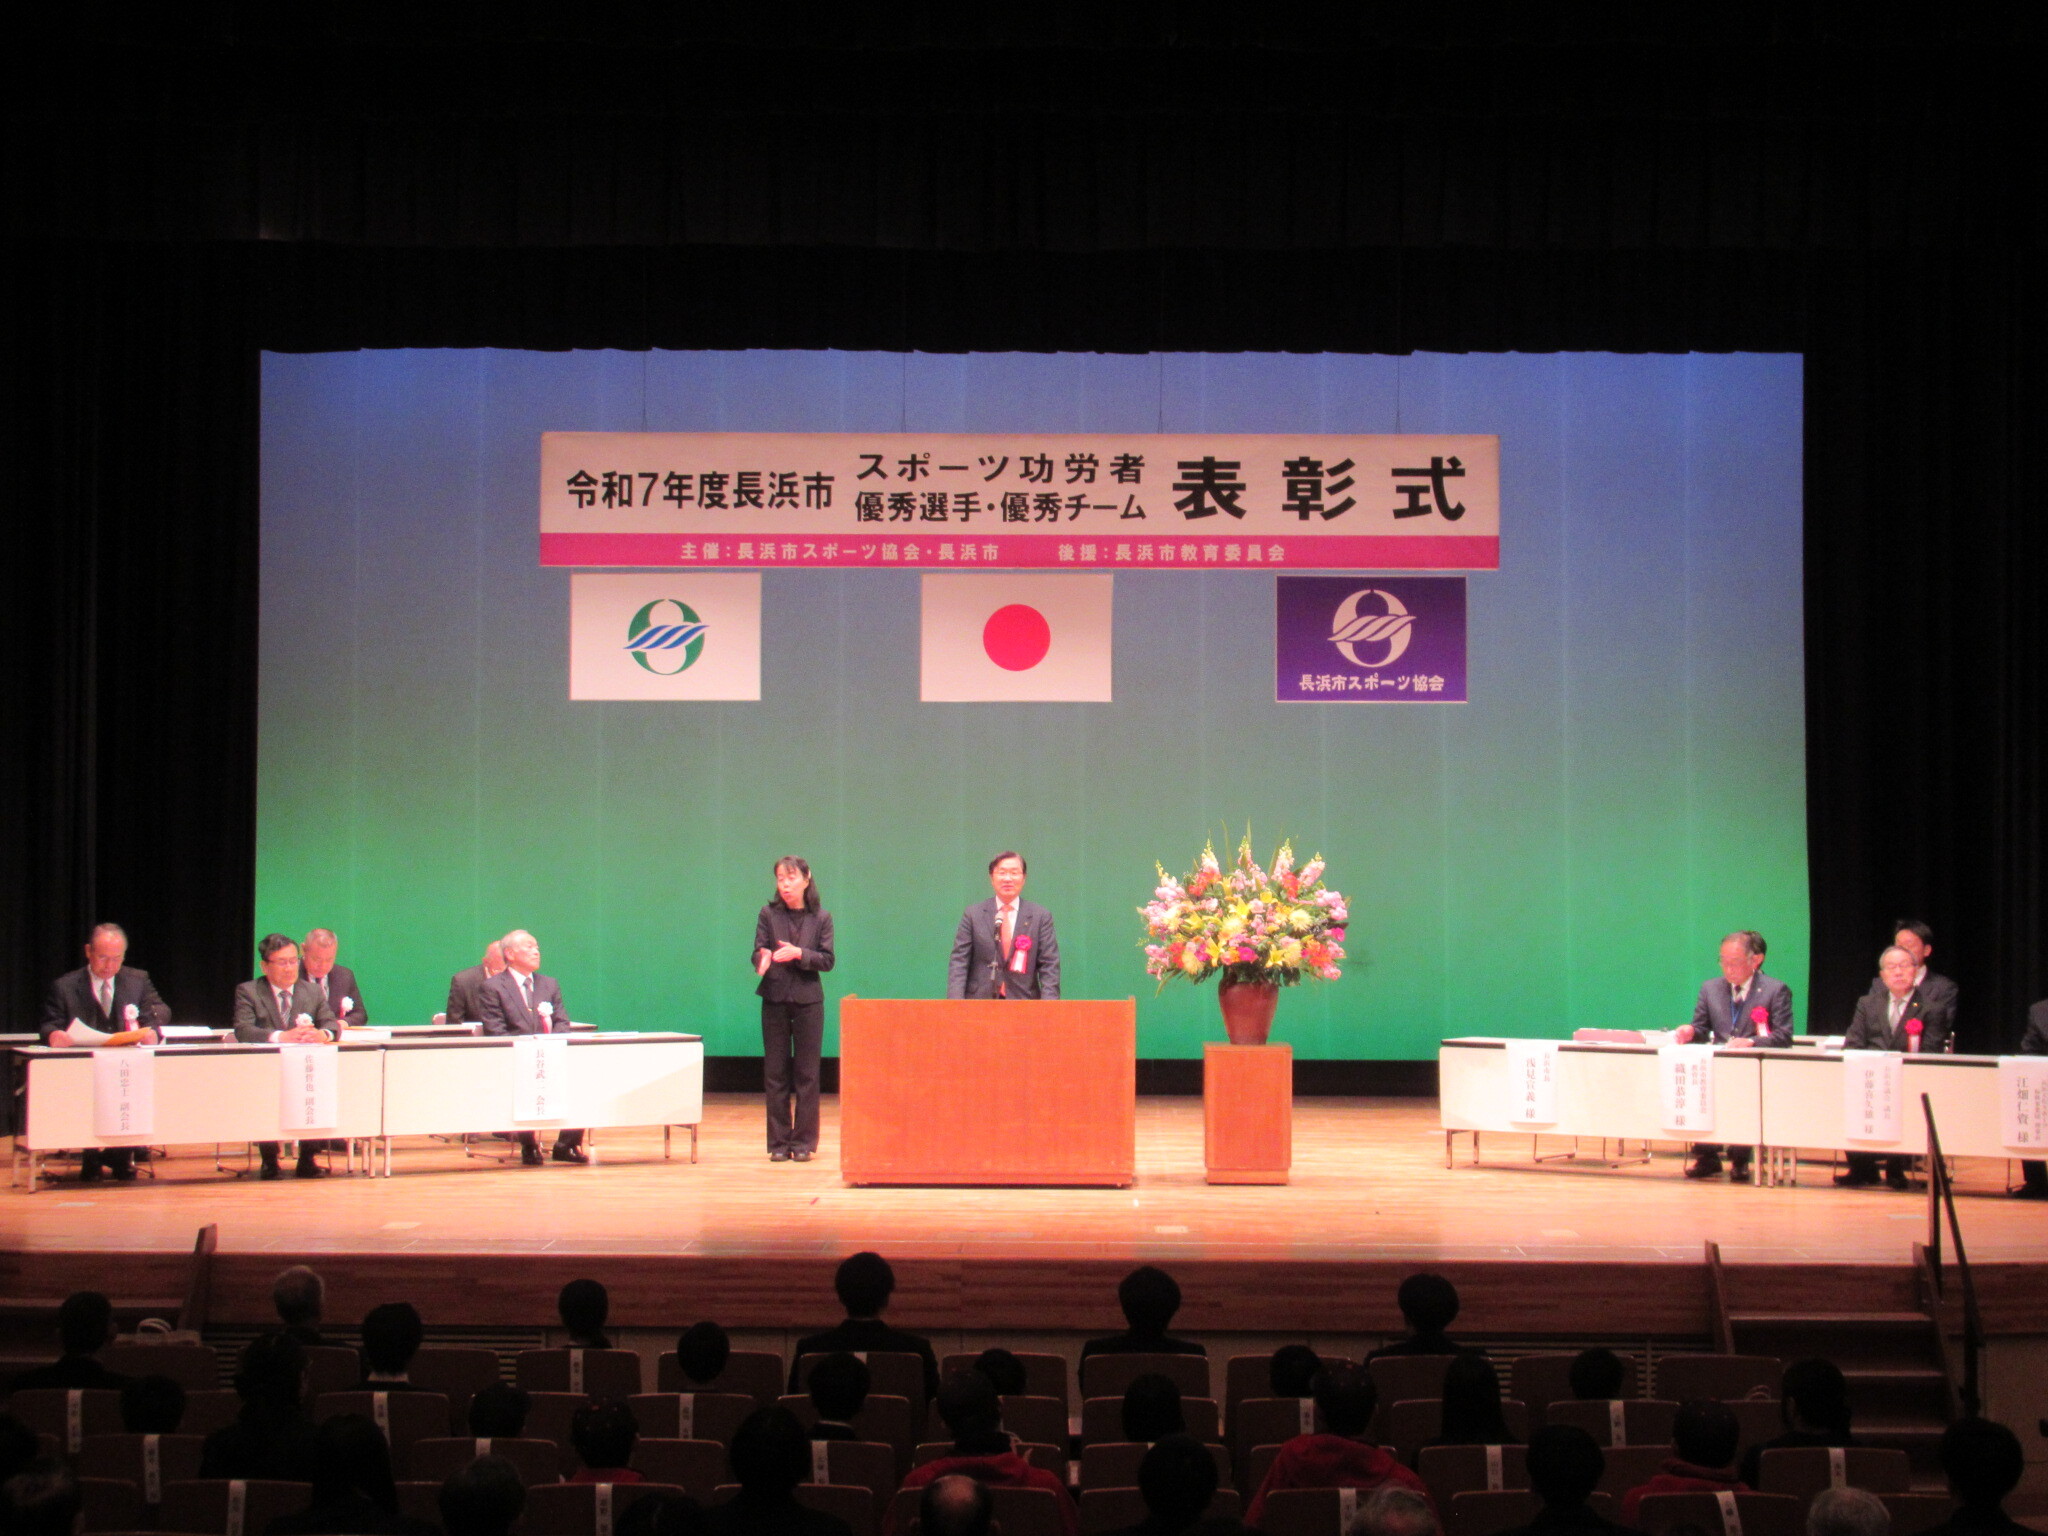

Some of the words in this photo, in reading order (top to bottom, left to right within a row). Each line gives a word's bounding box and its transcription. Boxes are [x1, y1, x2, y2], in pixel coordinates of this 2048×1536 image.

[856, 453, 1145, 485] スポーツ功労者
[566, 470, 835, 510] 令和7年度長浜市
[1172, 456, 1466, 521] 表彰式
[855, 491, 1146, 523] 優秀選手・優秀チーム
[1299, 673, 1445, 693] 長浜市スポーツ協会
